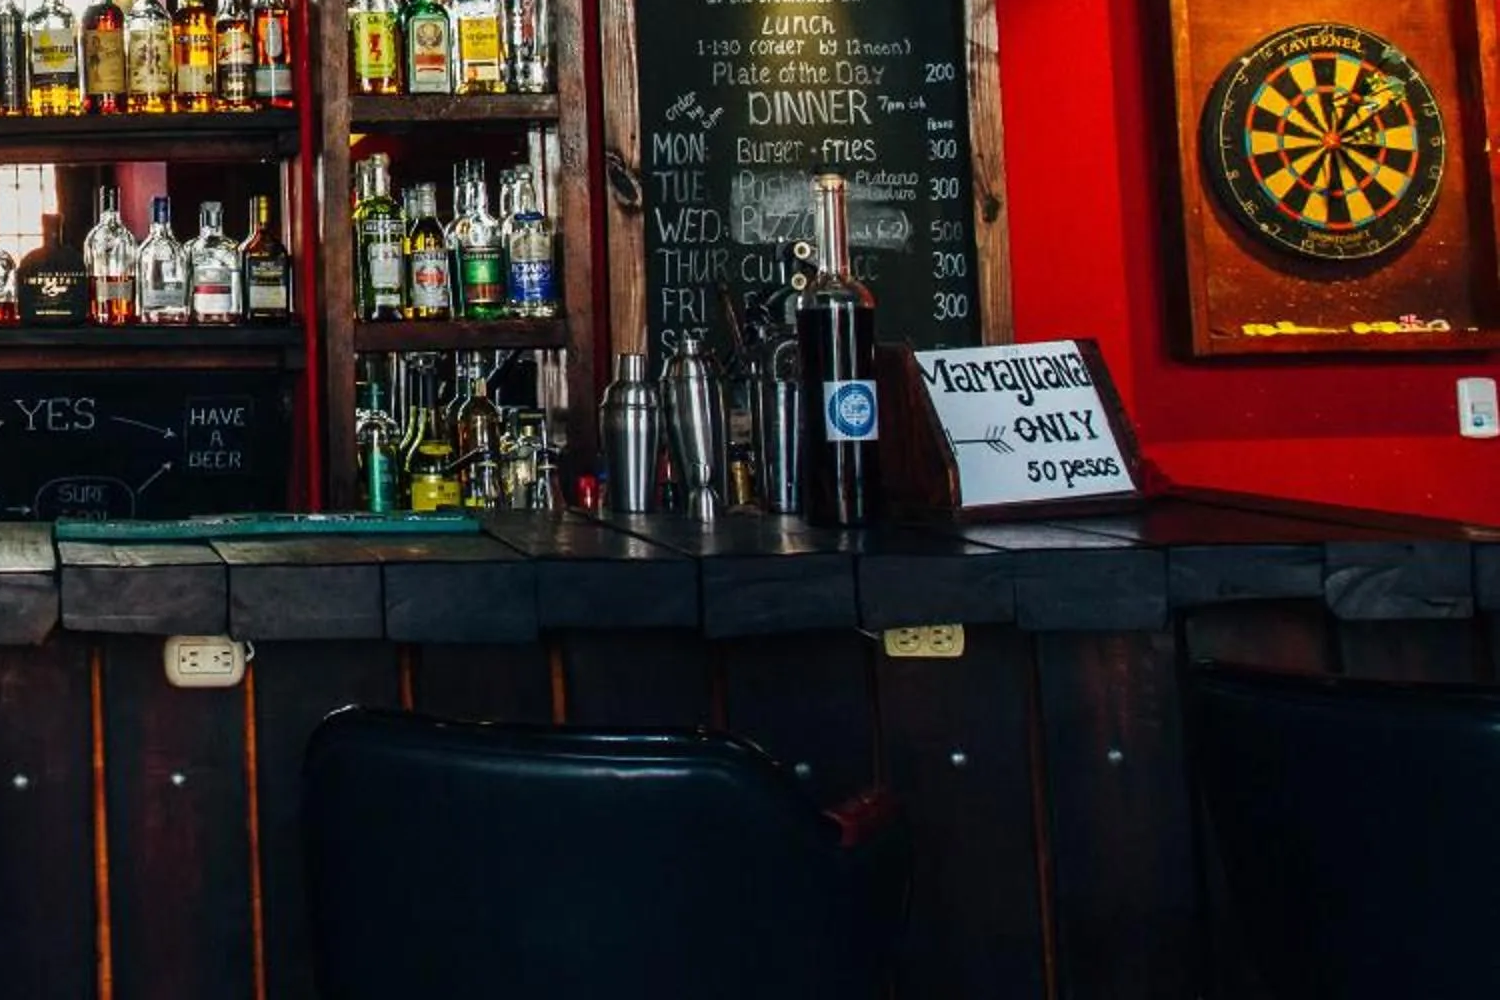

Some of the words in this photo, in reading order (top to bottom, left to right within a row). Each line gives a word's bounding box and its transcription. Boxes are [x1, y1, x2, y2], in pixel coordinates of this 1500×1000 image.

[761, 14, 837, 37] Lunch
[819, 39, 838, 56] by
[1279, 34, 1363, 59] TAVERNER
[712, 61, 773, 86] Plate
[778, 60, 798, 85] of
[799, 61, 831, 85] the
[835, 60, 886, 86] Day
[924, 63, 957, 85] 200
[747, 88, 874, 127] DINNER
[876, 95, 905, 114] 7pm
[736, 137, 805, 166] Burger
[820, 137, 878, 164] fries
[927, 138, 958, 161] 300
[928, 177, 960, 201] 300
[930, 219, 964, 243] 500
[655, 247, 730, 285] THUR
[932, 251, 968, 280] 300
[661, 287, 707, 324] FRI
[932, 292, 970, 321] 300
[13, 396, 97, 432] YES
[190, 406, 246, 428] HAVE
[1013, 409, 1100, 444] ONLY
[211, 430, 224, 447] A
[187, 450, 243, 470] BEER
[1027, 460, 1056, 483] 50
[1060, 456, 1121, 489] pesos
